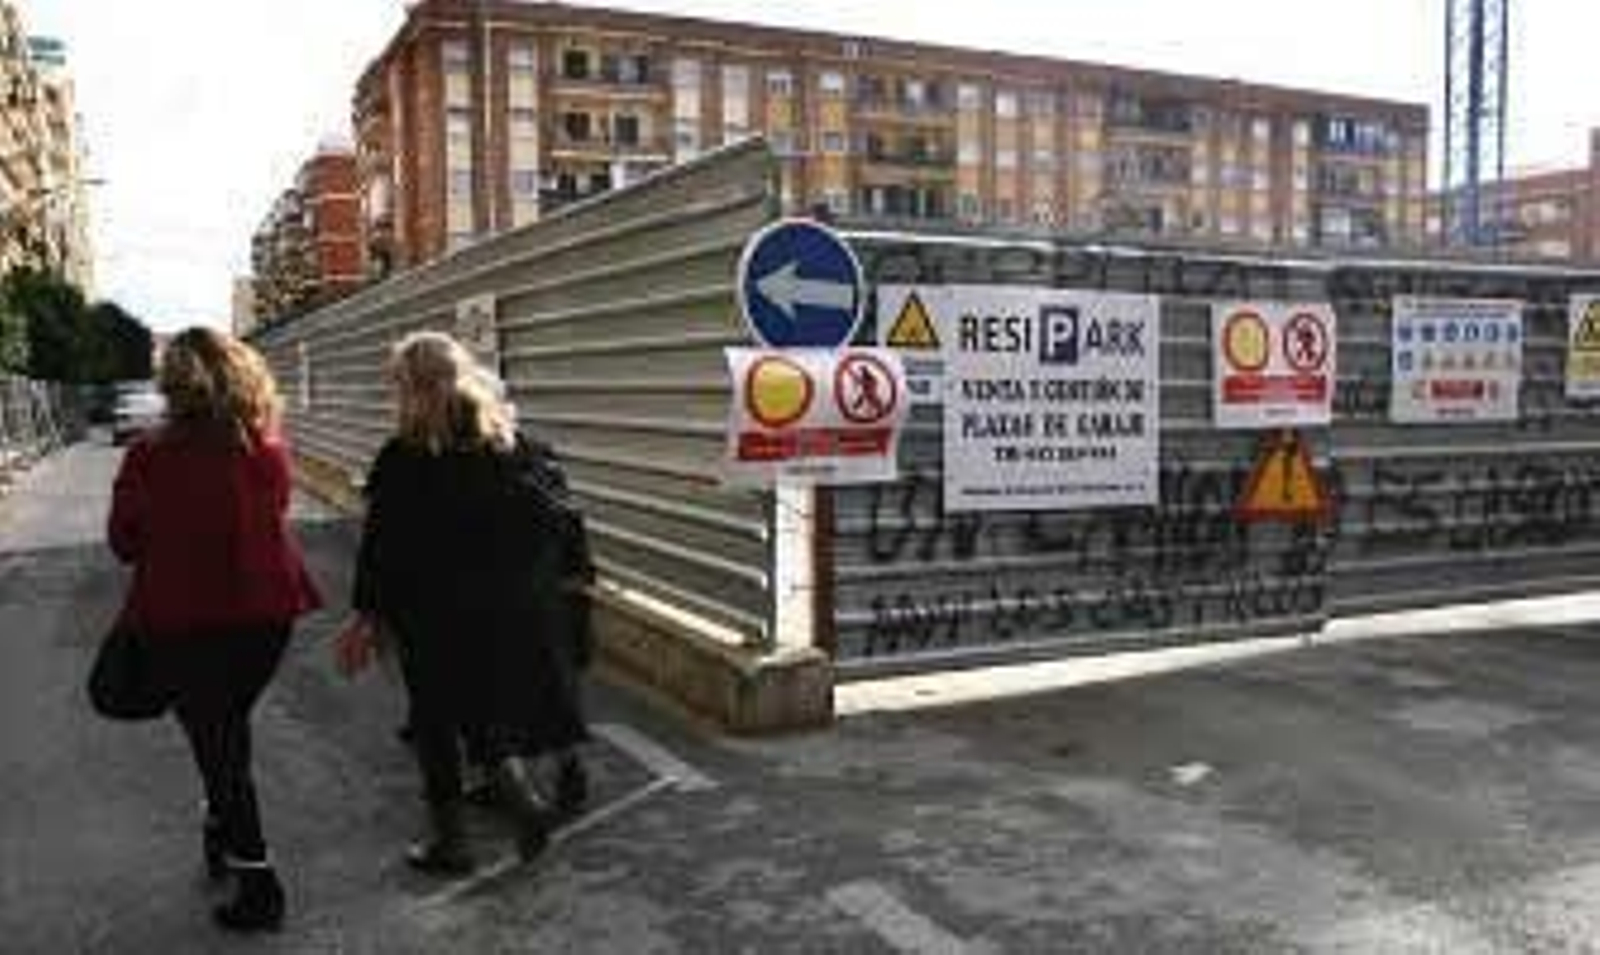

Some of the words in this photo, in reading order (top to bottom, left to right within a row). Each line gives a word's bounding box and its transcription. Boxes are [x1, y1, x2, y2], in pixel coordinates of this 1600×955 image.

[962, 379, 1025, 401] VENTA
[962, 413, 1032, 438] PLAZAS
[1044, 413, 1068, 437] DE
[1077, 413, 1145, 438] GARAJE
